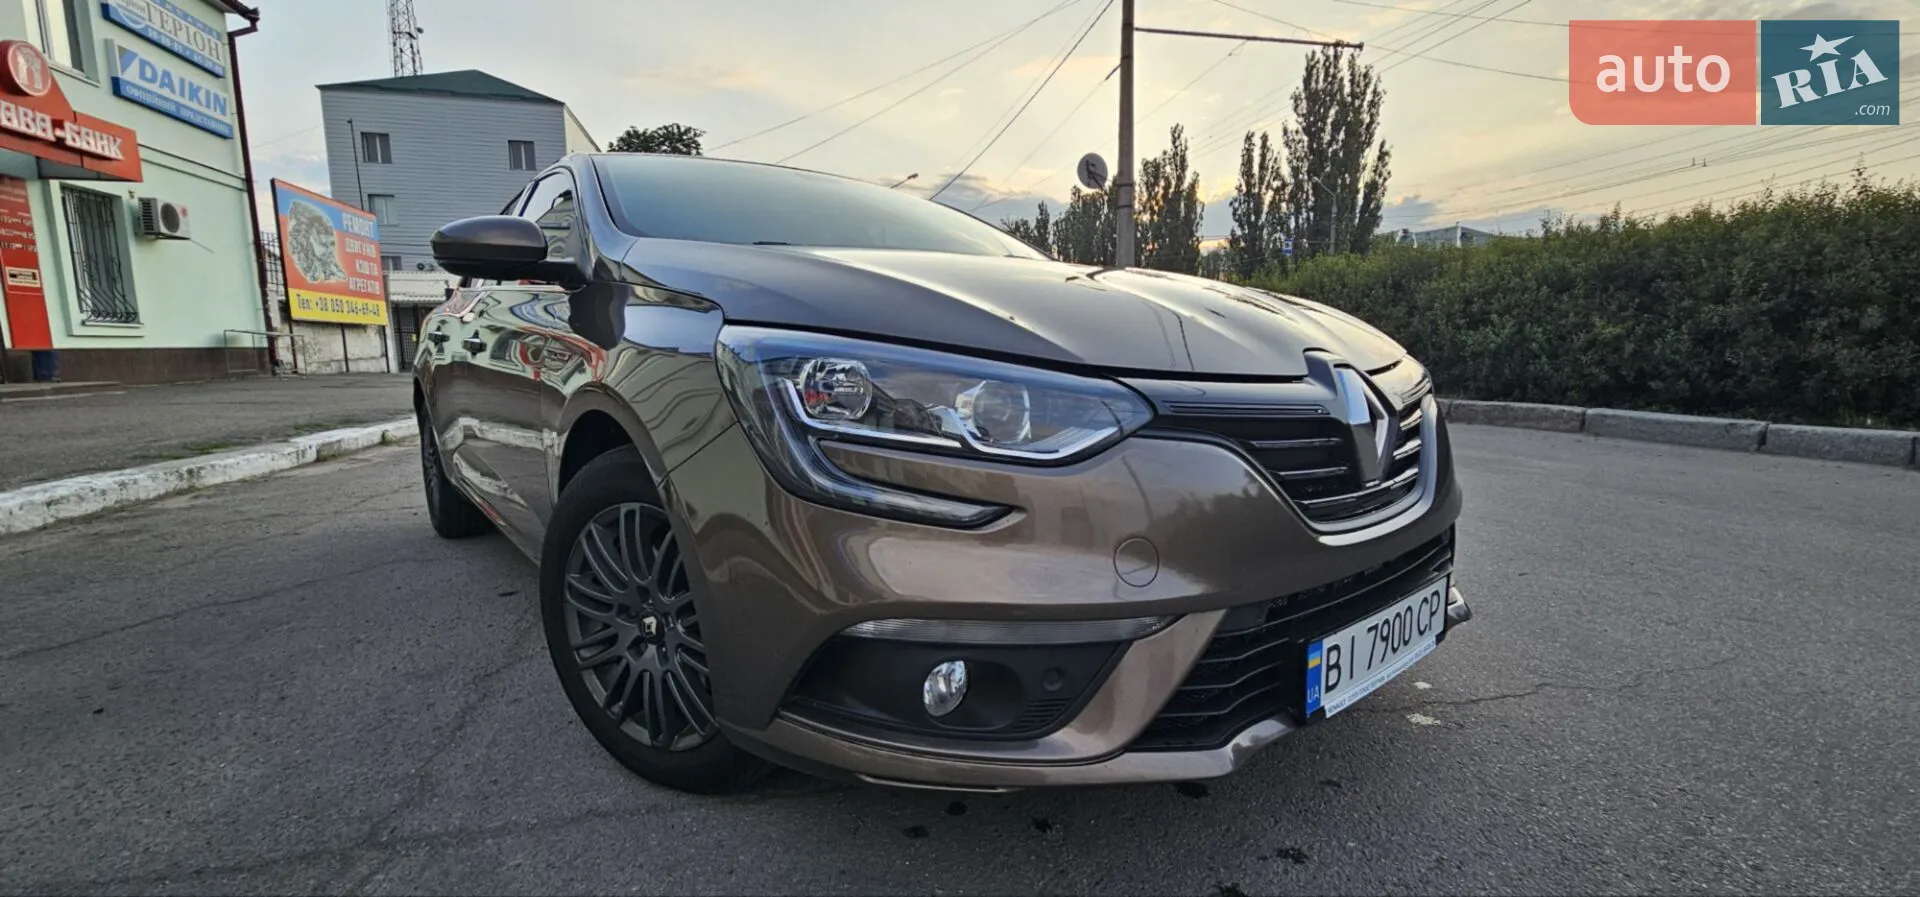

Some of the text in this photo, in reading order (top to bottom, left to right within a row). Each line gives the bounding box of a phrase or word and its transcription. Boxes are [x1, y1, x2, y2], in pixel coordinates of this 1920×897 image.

[146, 1, 221, 60] ГЕРІОН
[138, 57, 227, 117] DAIKIN
[0, 99, 124, 160] АВА-БАНК
[342, 212, 375, 238] РЕМОНТ
[315, 297, 328, 312] +38
[331, 298, 345, 313] 050
[1325, 635, 1355, 694] BI
[1366, 605, 1413, 671] 7900
[1417, 589, 1441, 636] CP
[1308, 685, 1320, 703] UA
